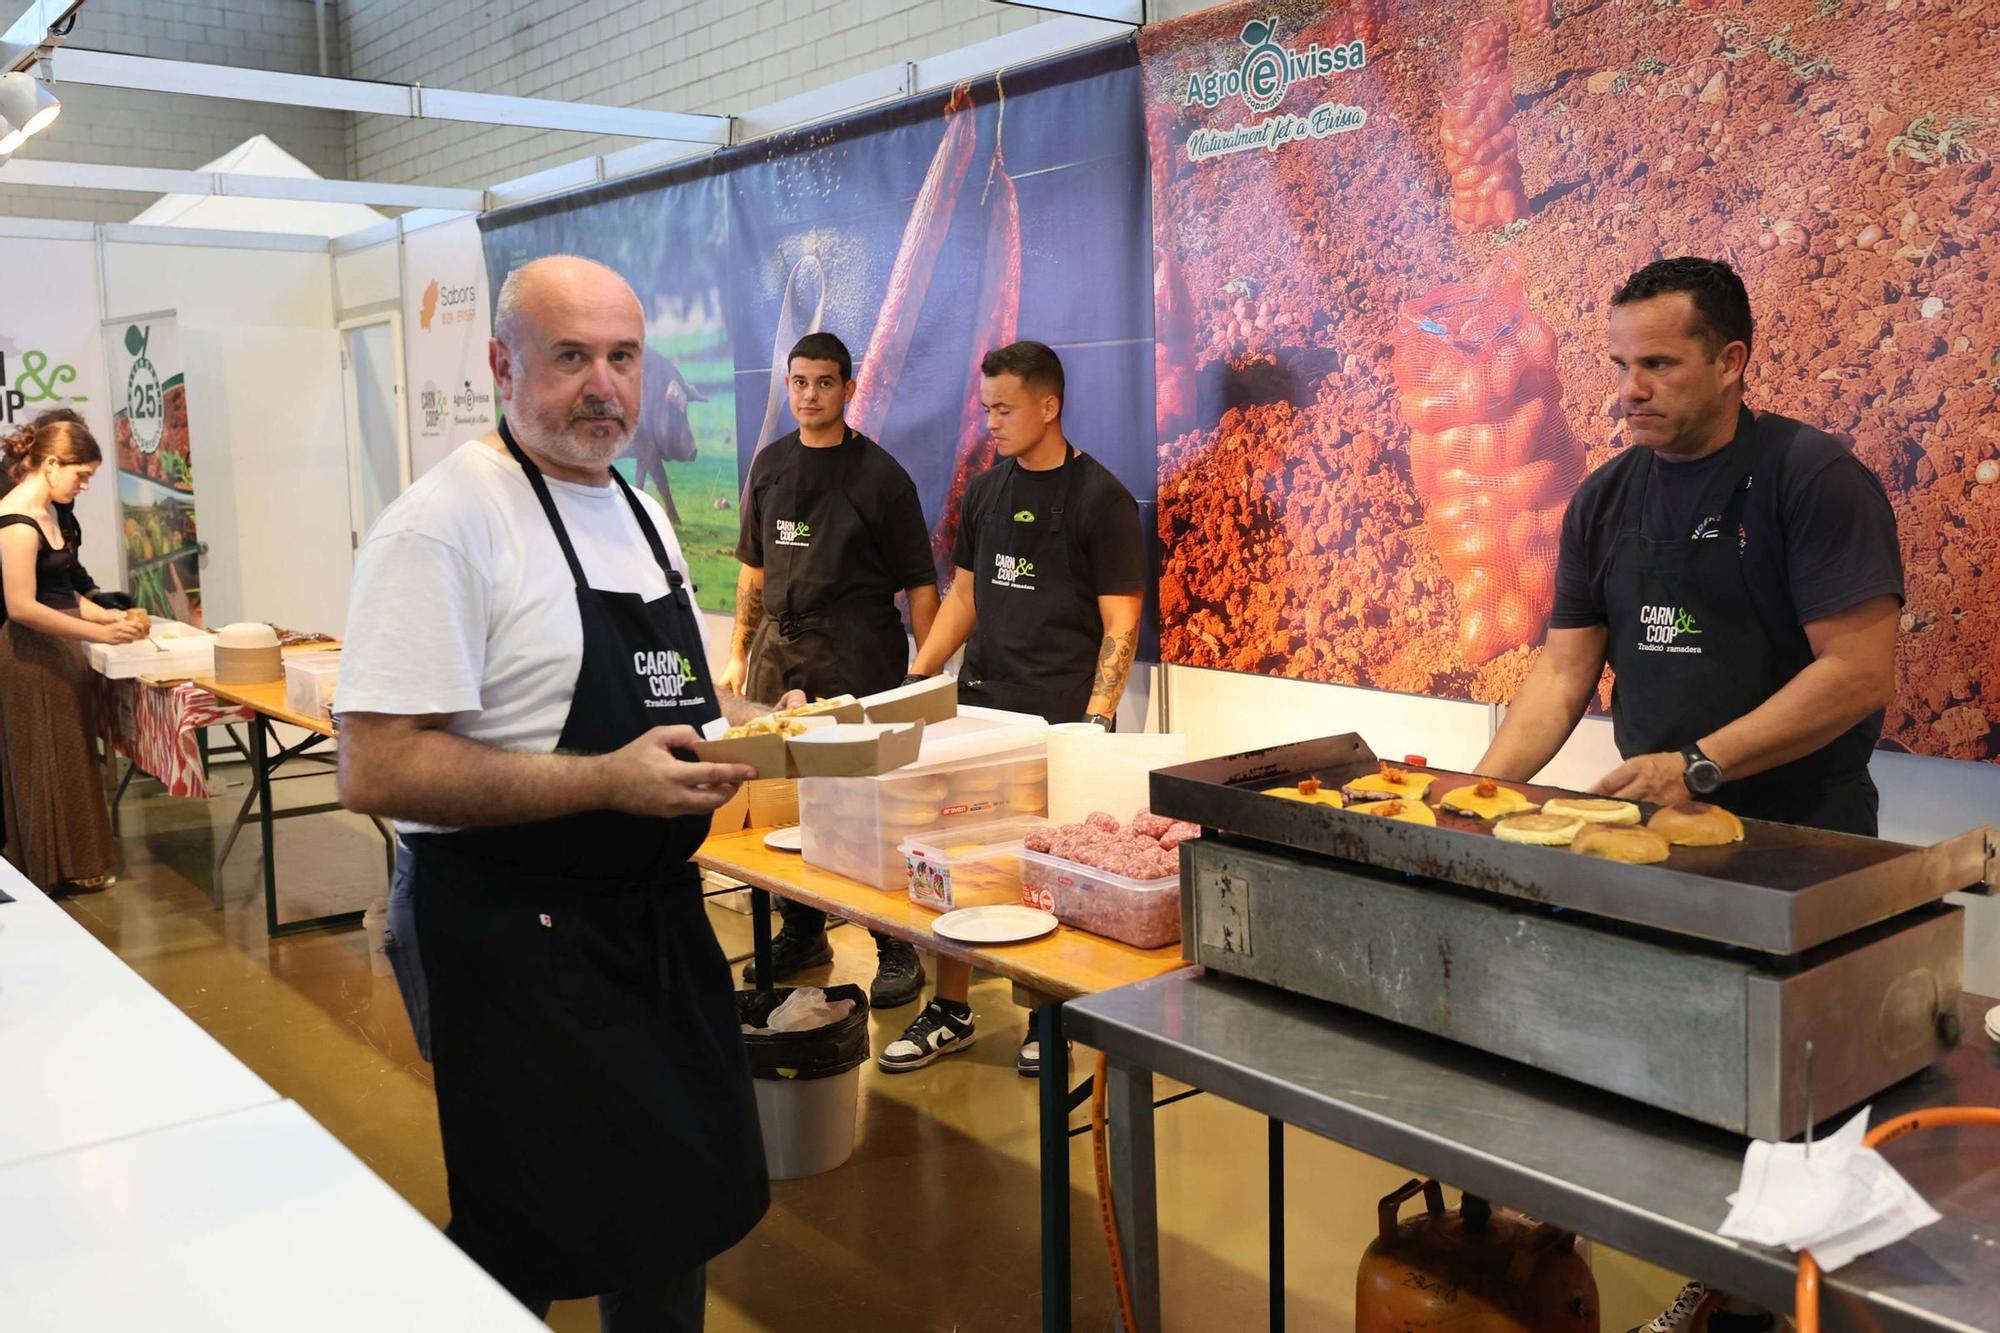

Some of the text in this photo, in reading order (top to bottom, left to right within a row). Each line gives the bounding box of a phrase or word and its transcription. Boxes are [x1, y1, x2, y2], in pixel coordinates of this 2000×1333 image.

[1243, 83, 1287, 111] cooperativa
[1189, 107, 1362, 157] Naturalment fet a Eivissa
[441, 284, 475, 306] Sabors
[134, 384, 157, 419] 25
[776, 520, 796, 532] CARN
[995, 553, 1016, 569] CARN
[998, 567, 1019, 582] COOP
[1640, 605, 1675, 626] CARN
[1646, 625, 1678, 644] COOP
[1638, 643, 1702, 653] Tradició ramadera
[634, 650, 679, 675] CARN
[649, 674, 686, 697] COOP
